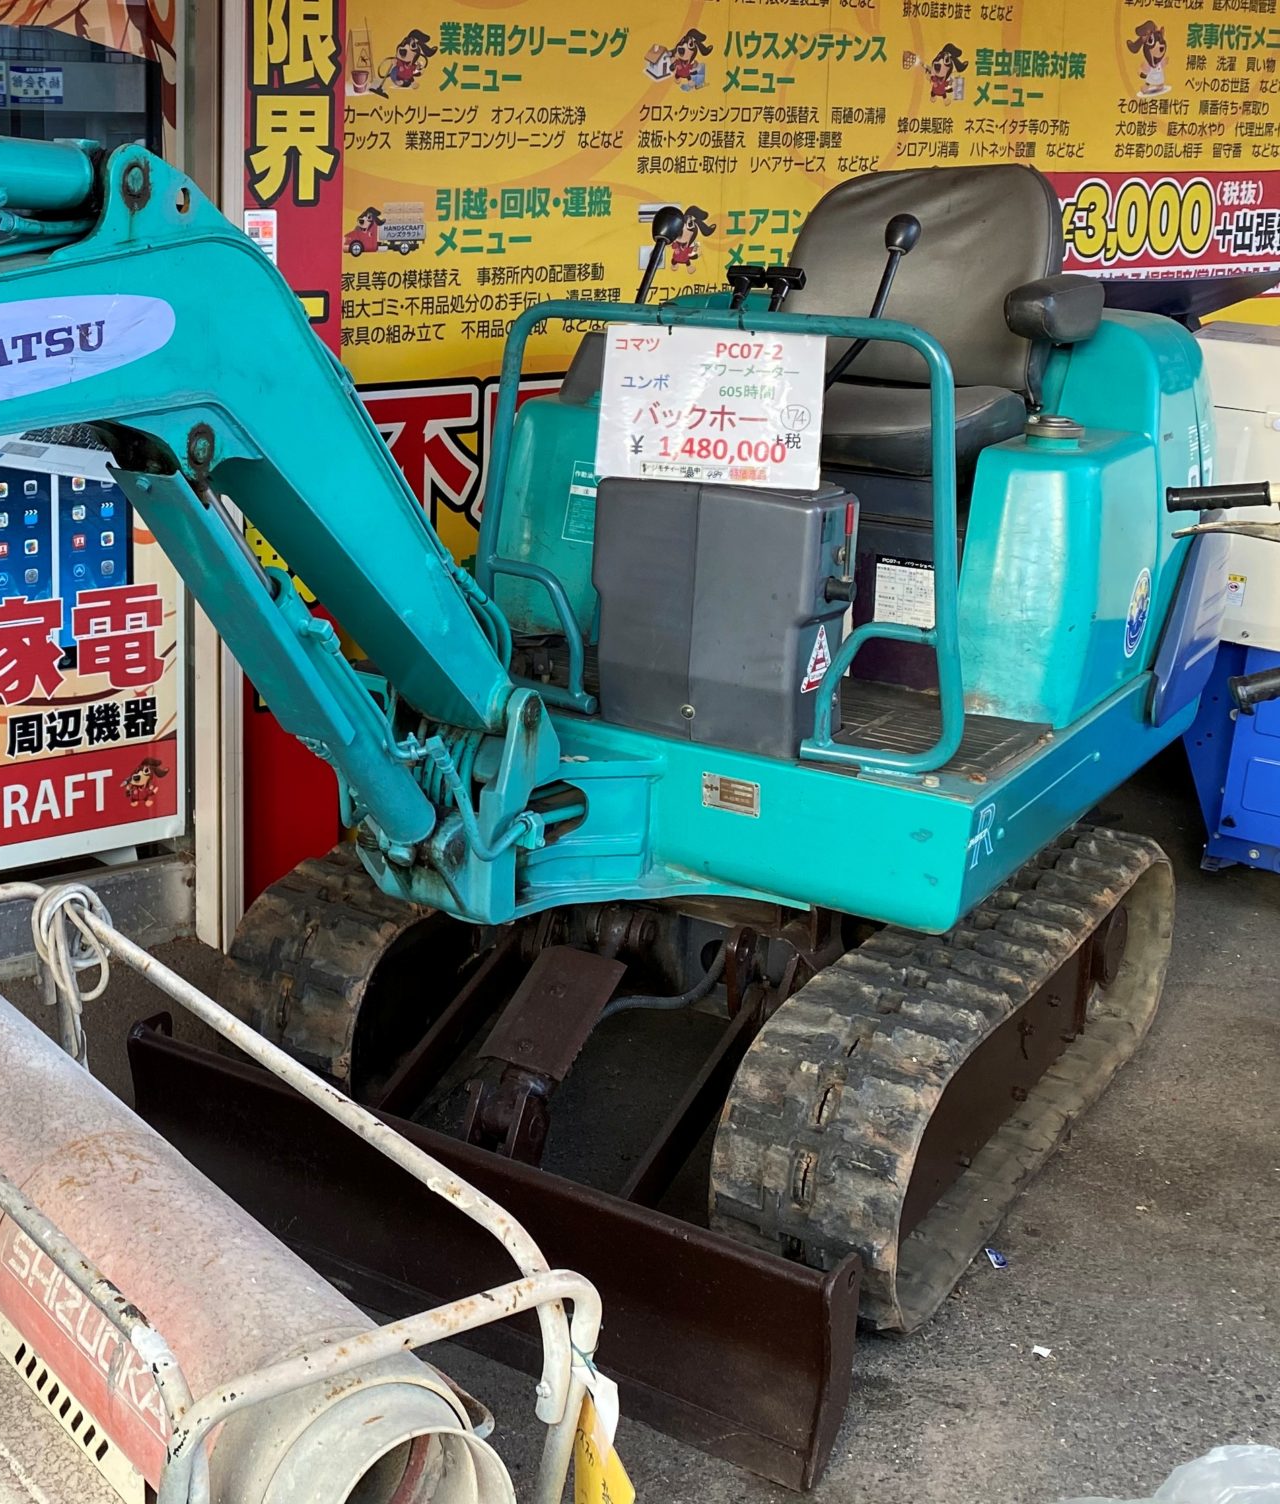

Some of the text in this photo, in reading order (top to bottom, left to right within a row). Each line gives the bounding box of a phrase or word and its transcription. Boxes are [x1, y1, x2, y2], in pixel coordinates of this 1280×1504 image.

[902, 1, 1013, 21] 排水の詰まり抜き などなど
[439, 22, 629, 58] 業務用クリーニング
[723, 30, 888, 63] ハウスメンテナンス
[975, 48, 1087, 79] 害虫駆除対策
[1186, 55, 1276, 73] 掃除 洗濯 買い物
[439, 62, 522, 92] メニュー
[722, 66, 795, 93] メニュー
[1185, 77, 1280, 94] ペットのお世話 など
[973, 82, 1044, 108] メニュー
[344, 105, 586, 125] カーペットクリーニング オフィスの床洗浄
[639, 105, 886, 125] クロス・クッションフロア等の張替え 雨樋の清掃
[1117, 98, 1270, 116] その他各種代行 順番待ち・席取り
[897, 117, 1070, 136] 蜂の巣駆除 ネズミ・イタチ等の予防
[1115, 121, 1280, 138] 犬の散歩 庭木の水やり 代理出席・
[344, 130, 624, 151] ワックス 業務用エアコンクリーニング などなど
[638, 131, 842, 149] 波板・トタンの張替え 建具の修理・調整
[896, 142, 1085, 159] シロアリ消毒 ハトネット設置 などなど
[1115, 143, 1203, 159] お年寄りの話し相手
[1212, 143, 1242, 158] 留守番
[637, 156, 879, 174] 家具の組立・取付け リペアサービス などなど
[436, 187, 612, 221] 引越・回収・運搬
[383, 224, 424, 232] HANDSCRAFT
[1215, 211, 1280, 256] +出張
[435, 227, 532, 256] メニュー
[725, 243, 792, 268] メニュ
[341, 262, 605, 291] 家具等の模様替え 事務所内の配置移動
[341, 293, 551, 319] 粗大ゴミ・不用品処分のお手伝い
[341, 322, 447, 347] 家具の組み立て
[461, 318, 548, 341] 不用品の取
[616, 337, 784, 361] コマツ PC07-2
[699, 363, 800, 378] アワーメーター
[621, 374, 670, 391] ユンボ
[719, 385, 775, 401] 605時間
[633, 401, 768, 431] バックホー
[658, 435, 787, 465] 1,480,000
[6, 696, 158, 760] 周辺機器
